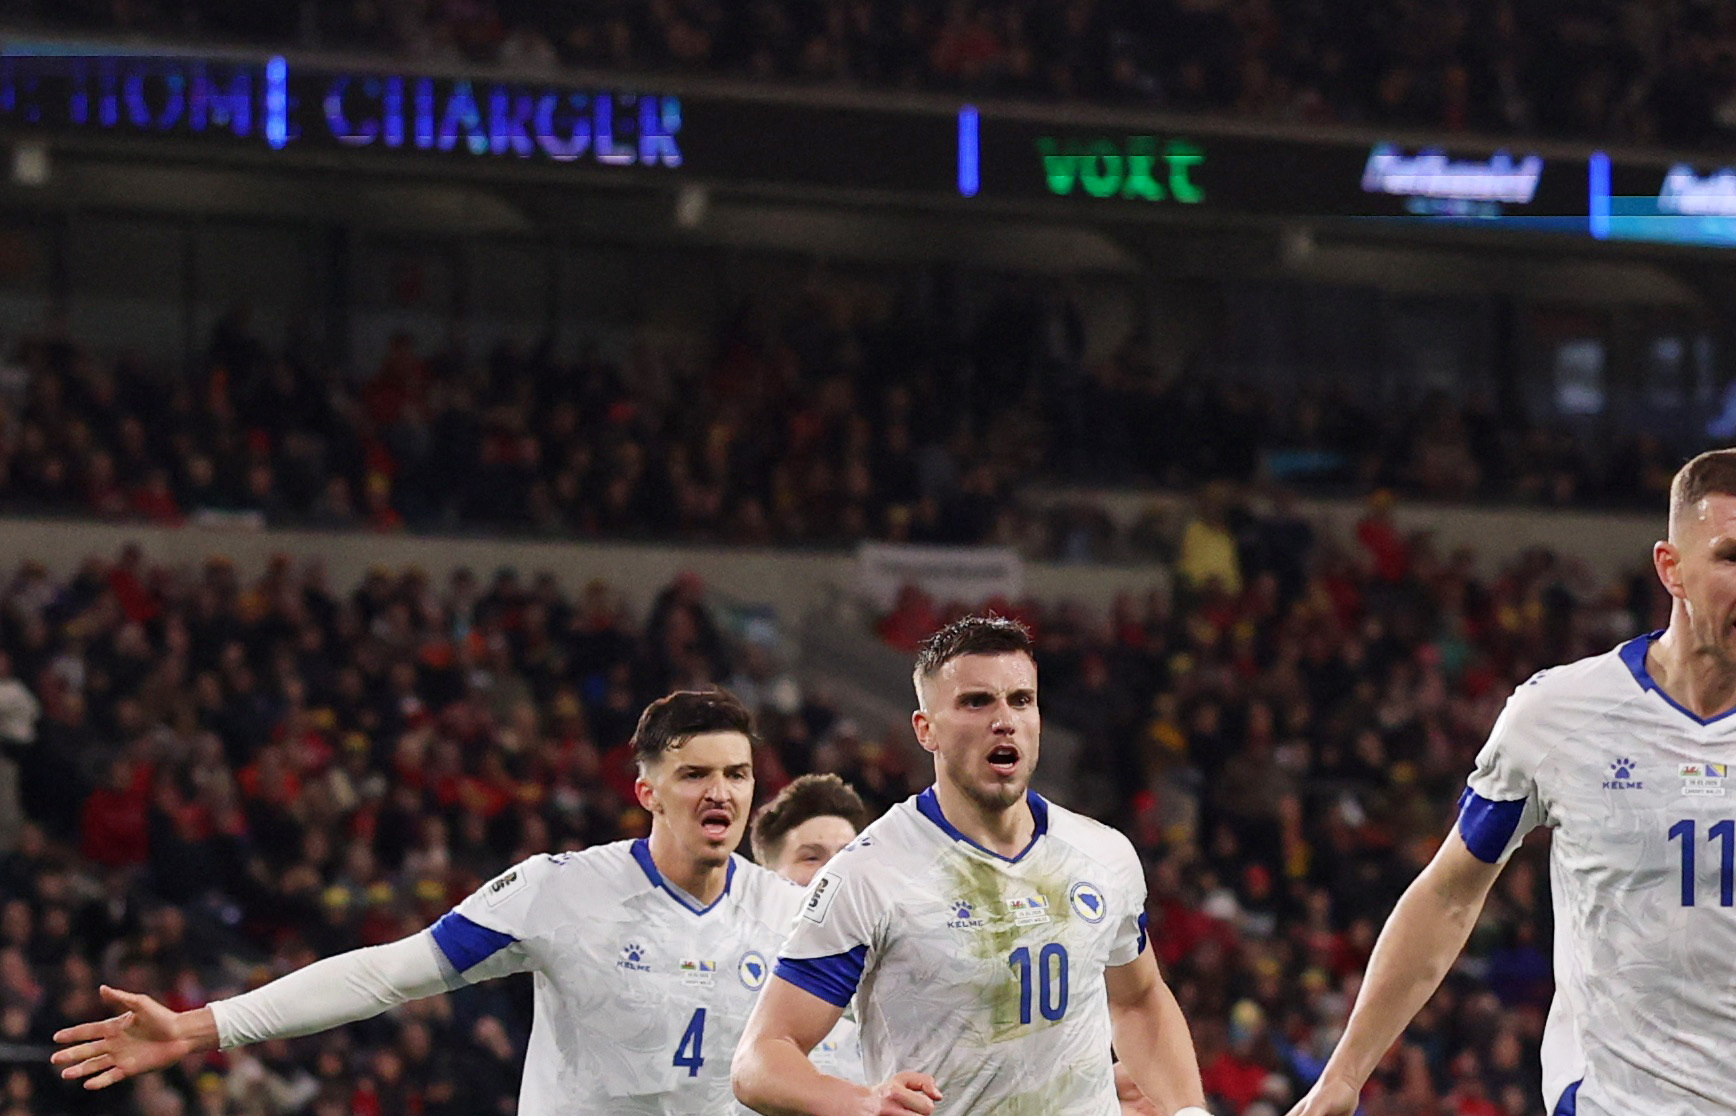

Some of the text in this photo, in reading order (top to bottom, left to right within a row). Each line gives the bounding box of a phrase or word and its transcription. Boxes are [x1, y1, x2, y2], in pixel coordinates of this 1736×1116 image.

[1602, 781, 1643, 789] KELME
[1668, 819, 1735, 907] 11
[946, 920, 983, 928] KELME
[1009, 942, 1068, 1024] 10
[672, 1008, 707, 1077] 4
